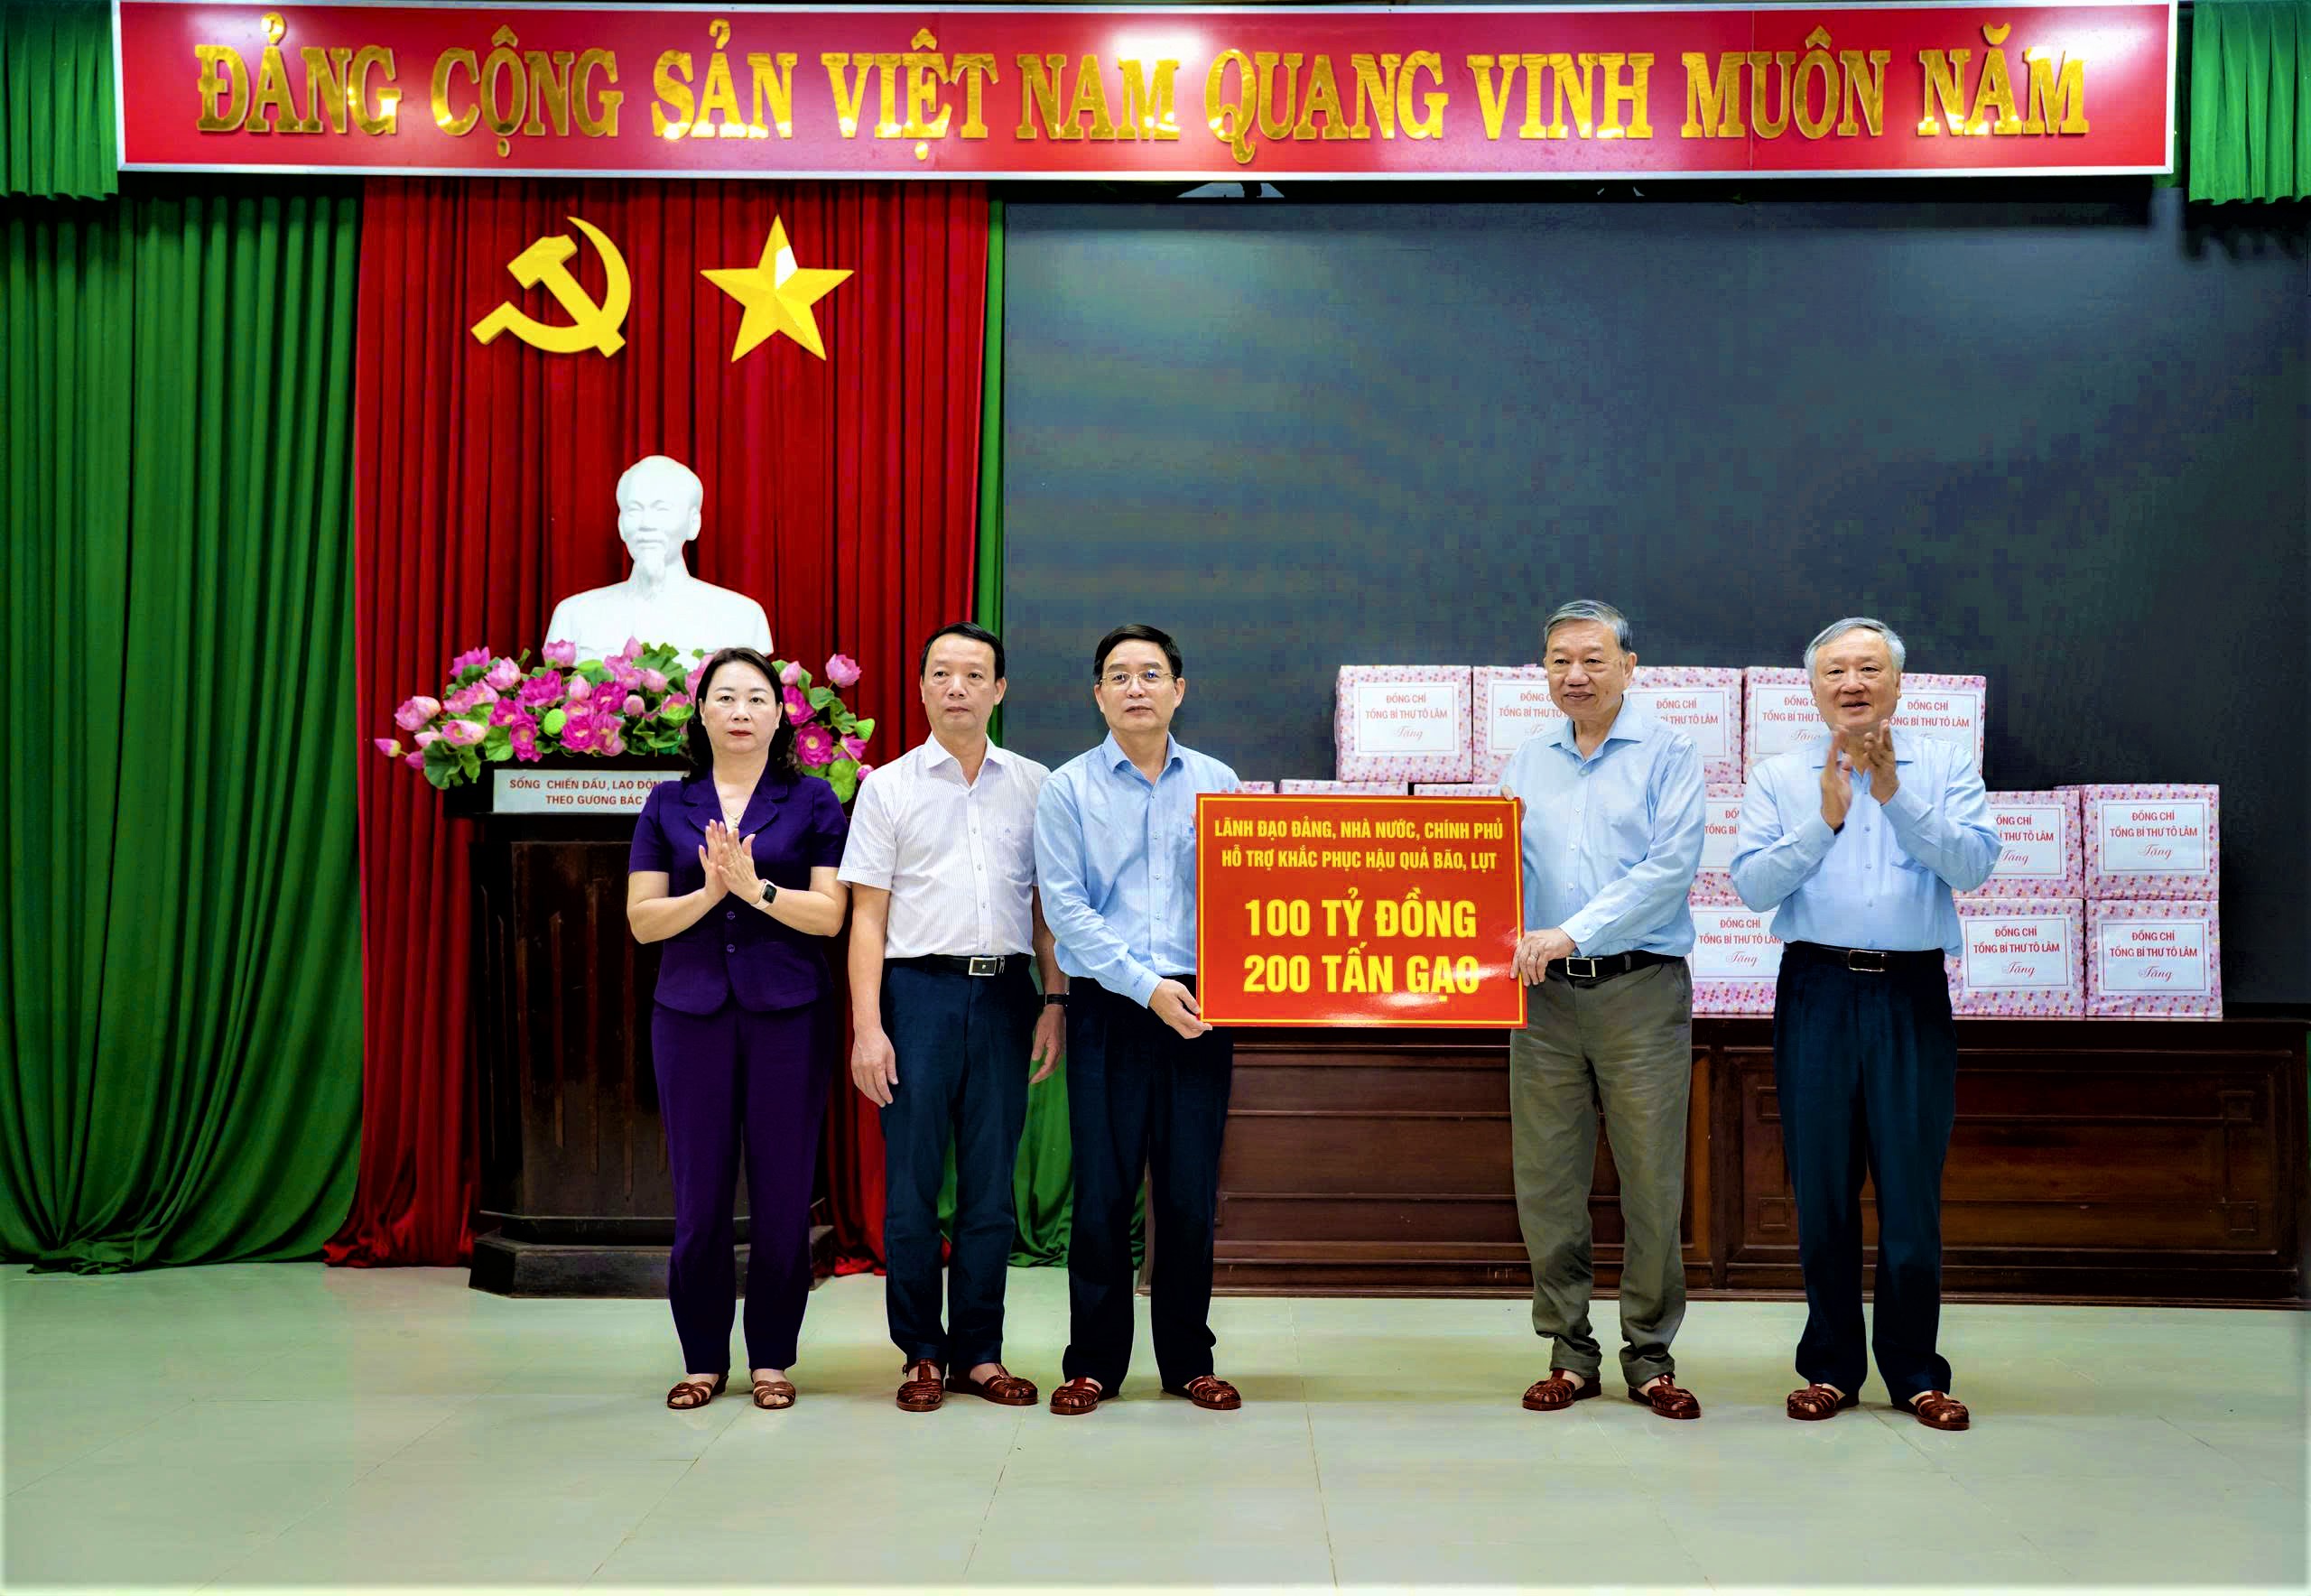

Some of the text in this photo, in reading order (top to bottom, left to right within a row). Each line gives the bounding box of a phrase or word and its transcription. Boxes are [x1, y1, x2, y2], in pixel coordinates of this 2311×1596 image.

[195, 12, 2090, 164] ĐẢNG CỘNG SẢN VIỆT NAM QUANG VINH MUÔN NĂM
[1430, 708, 1448, 719] LÂM
[1701, 714, 1719, 724] LÂM
[1890, 715, 1908, 726] ỔNG
[1921, 717, 1938, 727] THƯ
[1939, 716, 1950, 727] TÔ
[1952, 716, 1970, 728] LÂM
[509, 775, 540, 789] SỐNG
[547, 777, 579, 789] CHIẾN
[612, 781, 634, 790] LAO
[545, 795, 573, 804] THEO
[620, 794, 642, 804] BÁC
[1996, 814, 2015, 825] ỒNG
[1214, 815, 1504, 841] LÃNH ĐẠO ĐẢNG, NHÀ NƯỚC, CHÍNH PHỦ
[2146, 827, 2165, 837] THƯ
[2166, 825, 2176, 837] TÔ
[2179, 825, 2197, 837] LÂM
[2005, 831, 2021, 841] THƯ
[2023, 830, 2034, 841] TÔ
[2037, 830, 2054, 841] LÂM
[1221, 844, 1498, 873] HỖ TRỢ KHẮC PHỤC HẬU QUẢ BÃO, LỤT
[1245, 886, 1477, 938] 100 TỶ ĐỒNG
[1733, 934, 1750, 944] THƯ
[2009, 942, 2027, 952] THƯ
[2028, 942, 2039, 952] TÔ
[2042, 941, 2060, 952] LÂM
[2146, 947, 2165, 957] THƯ
[2166, 946, 2176, 957] TÔ
[2179, 946, 2197, 957] LÂM
[1243, 942, 1480, 1002] 200 TẤN GẠO
